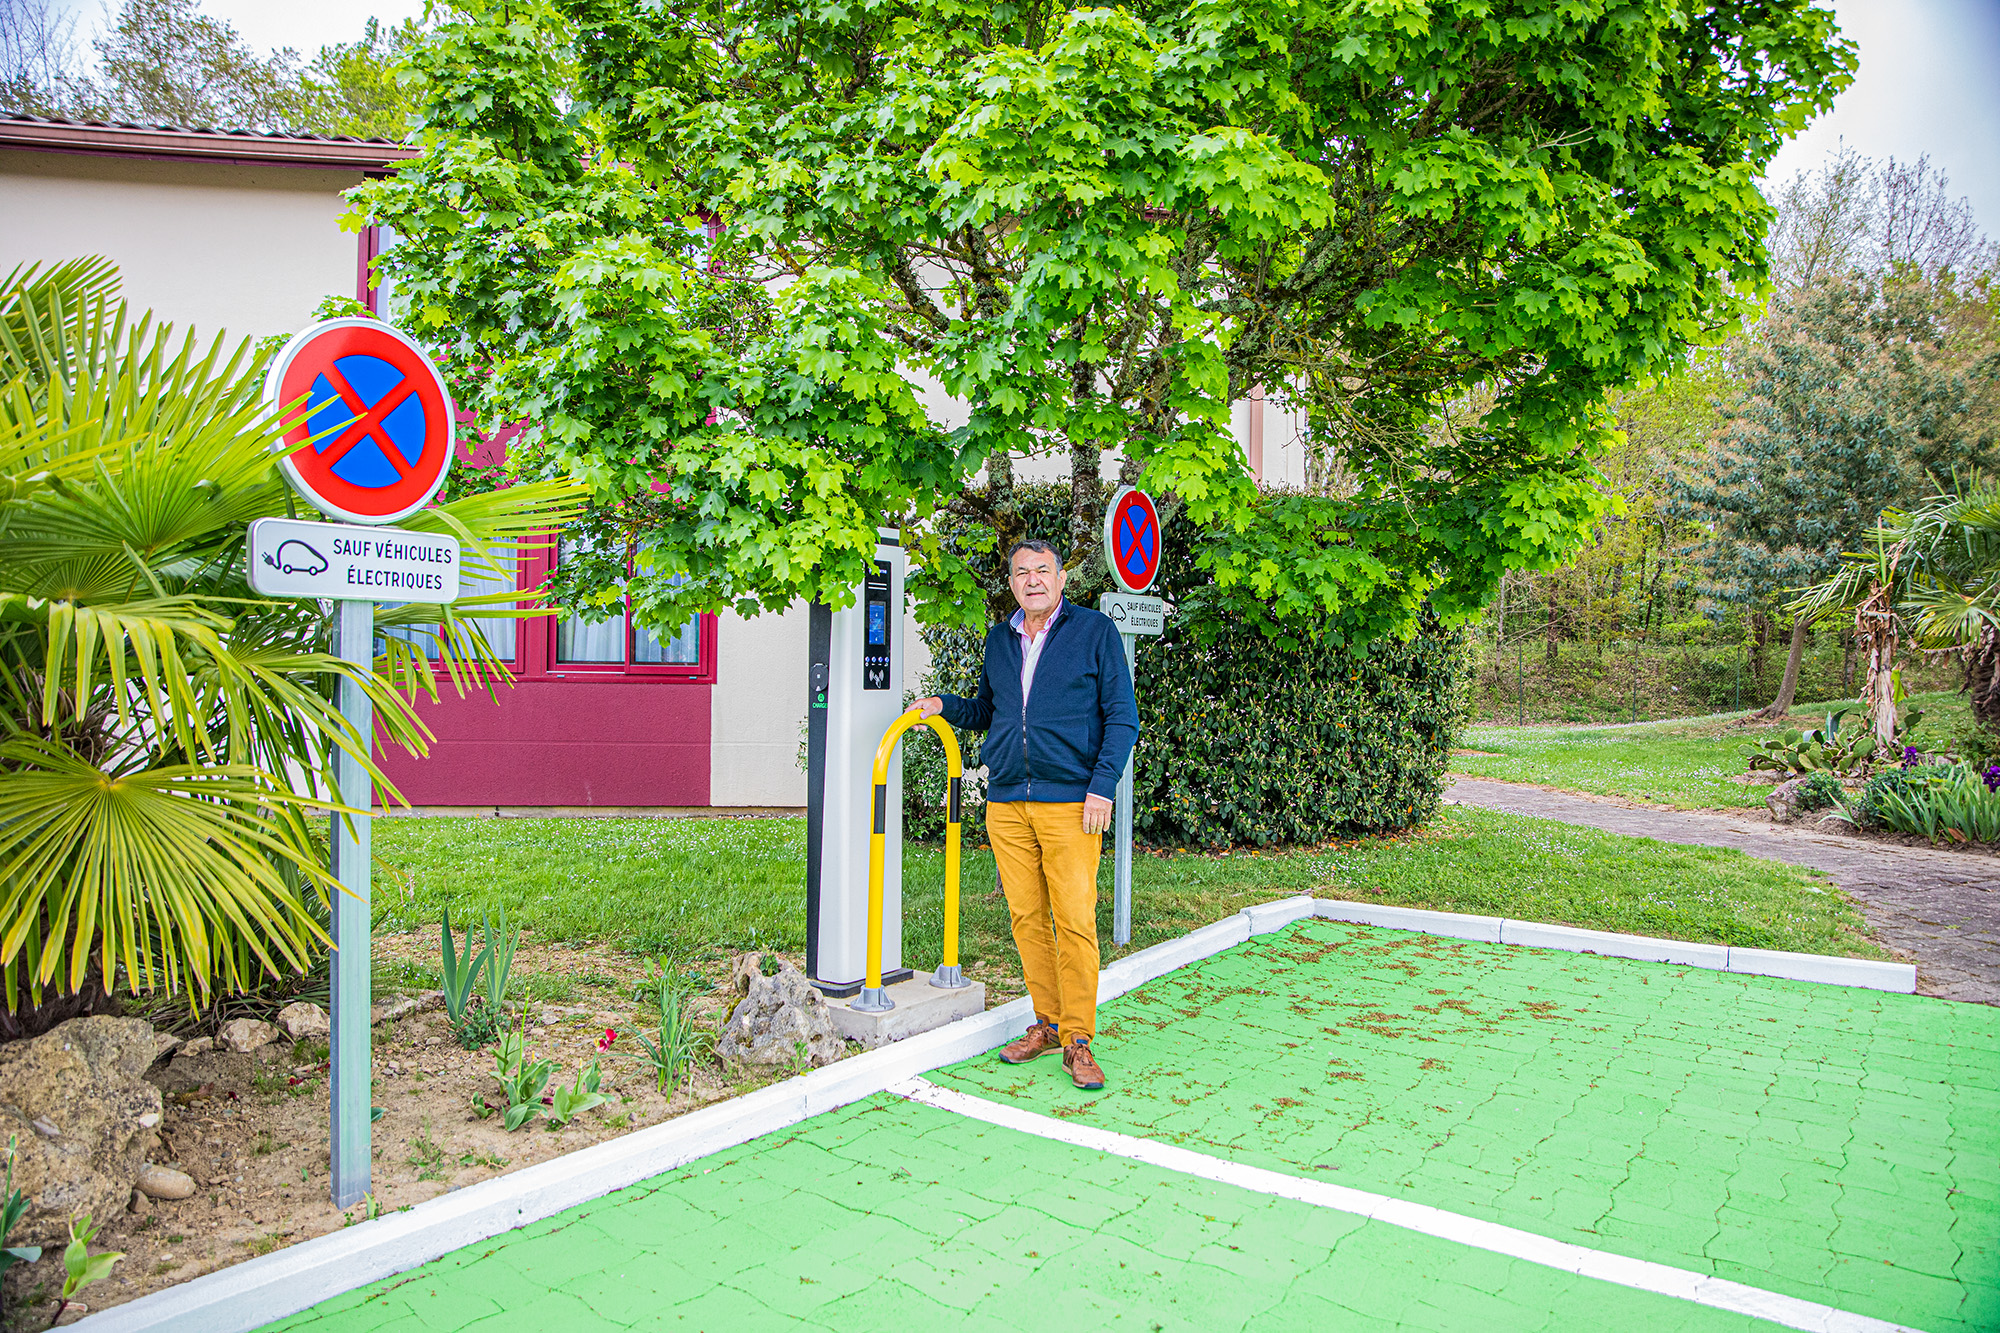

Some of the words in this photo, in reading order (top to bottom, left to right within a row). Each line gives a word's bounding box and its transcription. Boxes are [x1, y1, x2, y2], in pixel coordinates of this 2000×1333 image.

[333, 538, 371, 556] SAUF
[375, 540, 451, 563] VÉHICULES
[347, 564, 443, 590] ÉLECTRIQUES
[1127, 601, 1138, 611] SAUF
[1139, 601, 1161, 613] VÉHICULES
[1131, 615, 1158, 627] ÉLECTRIQUES
